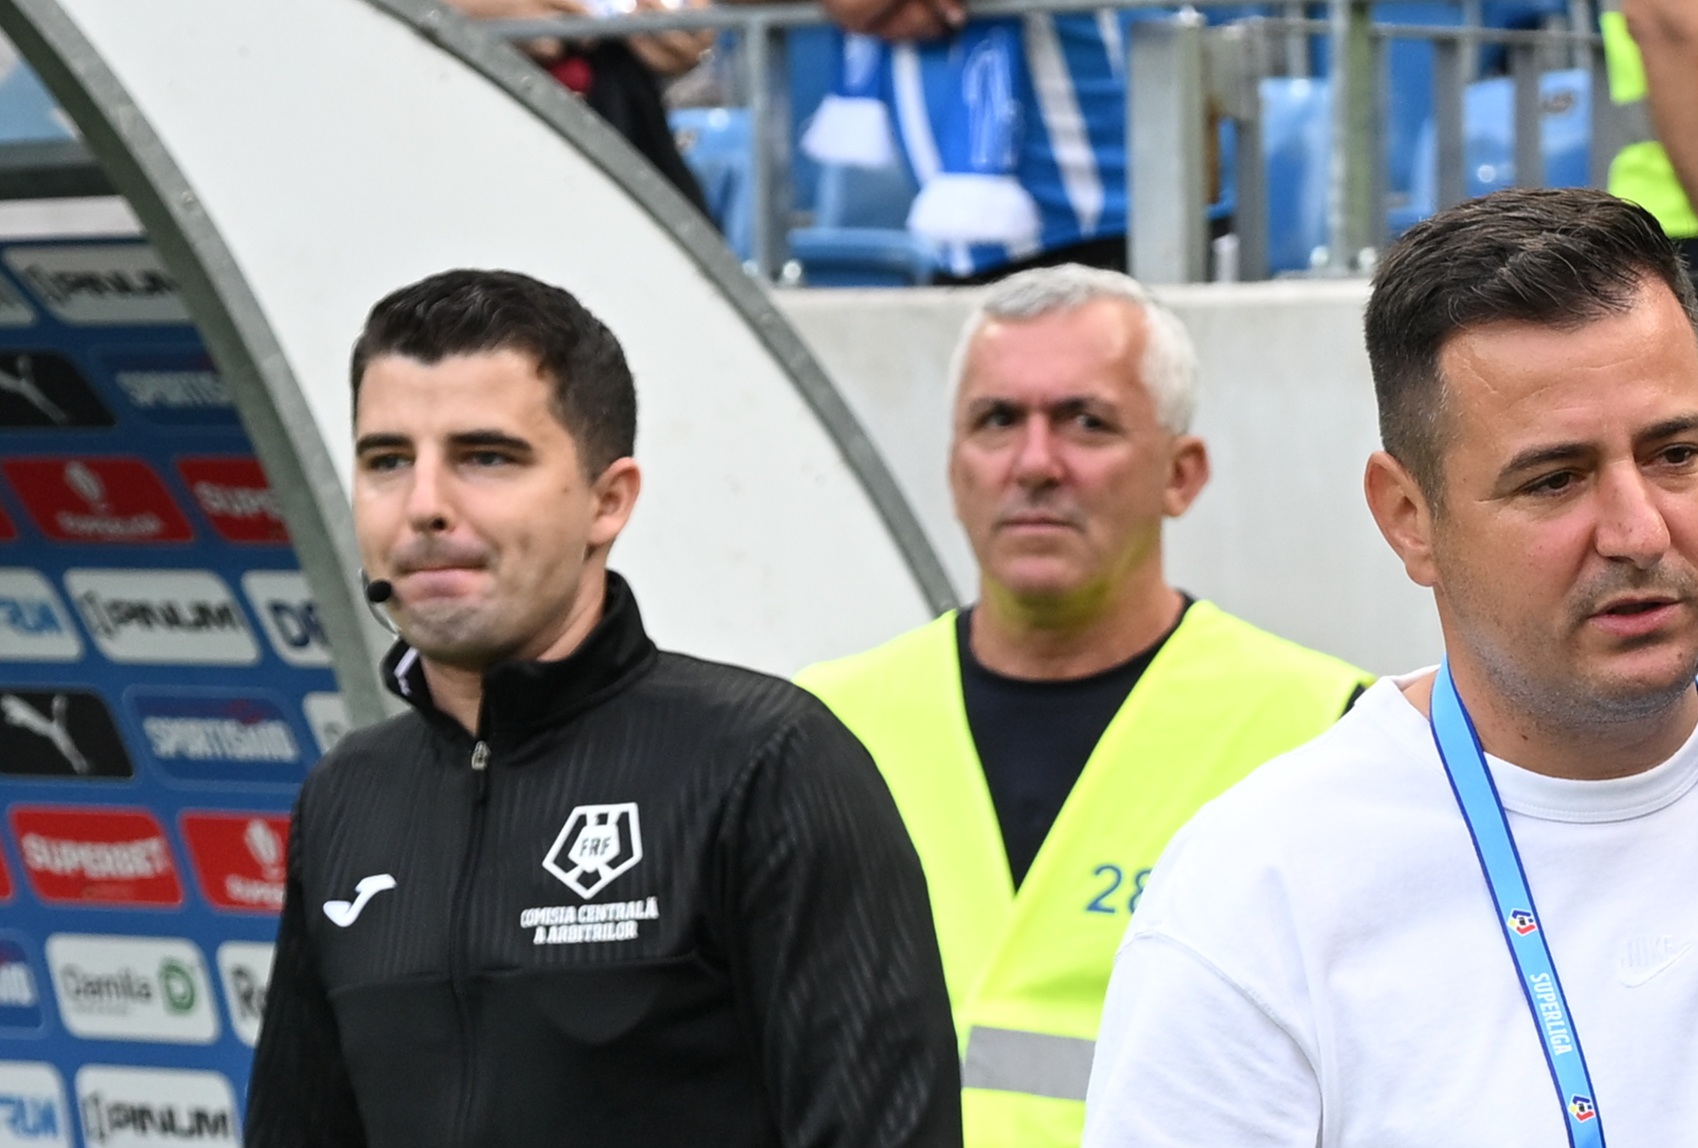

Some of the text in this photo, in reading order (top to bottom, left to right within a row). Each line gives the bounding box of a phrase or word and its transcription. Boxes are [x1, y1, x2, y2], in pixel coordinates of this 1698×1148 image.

[21, 832, 170, 882] SUPERBET
[579, 836, 611, 857] FRF
[520, 906, 577, 929] COMISIA
[533, 920, 639, 945] A ARBITRILOR
[1529, 972, 1573, 1056] SUPERLIGA
